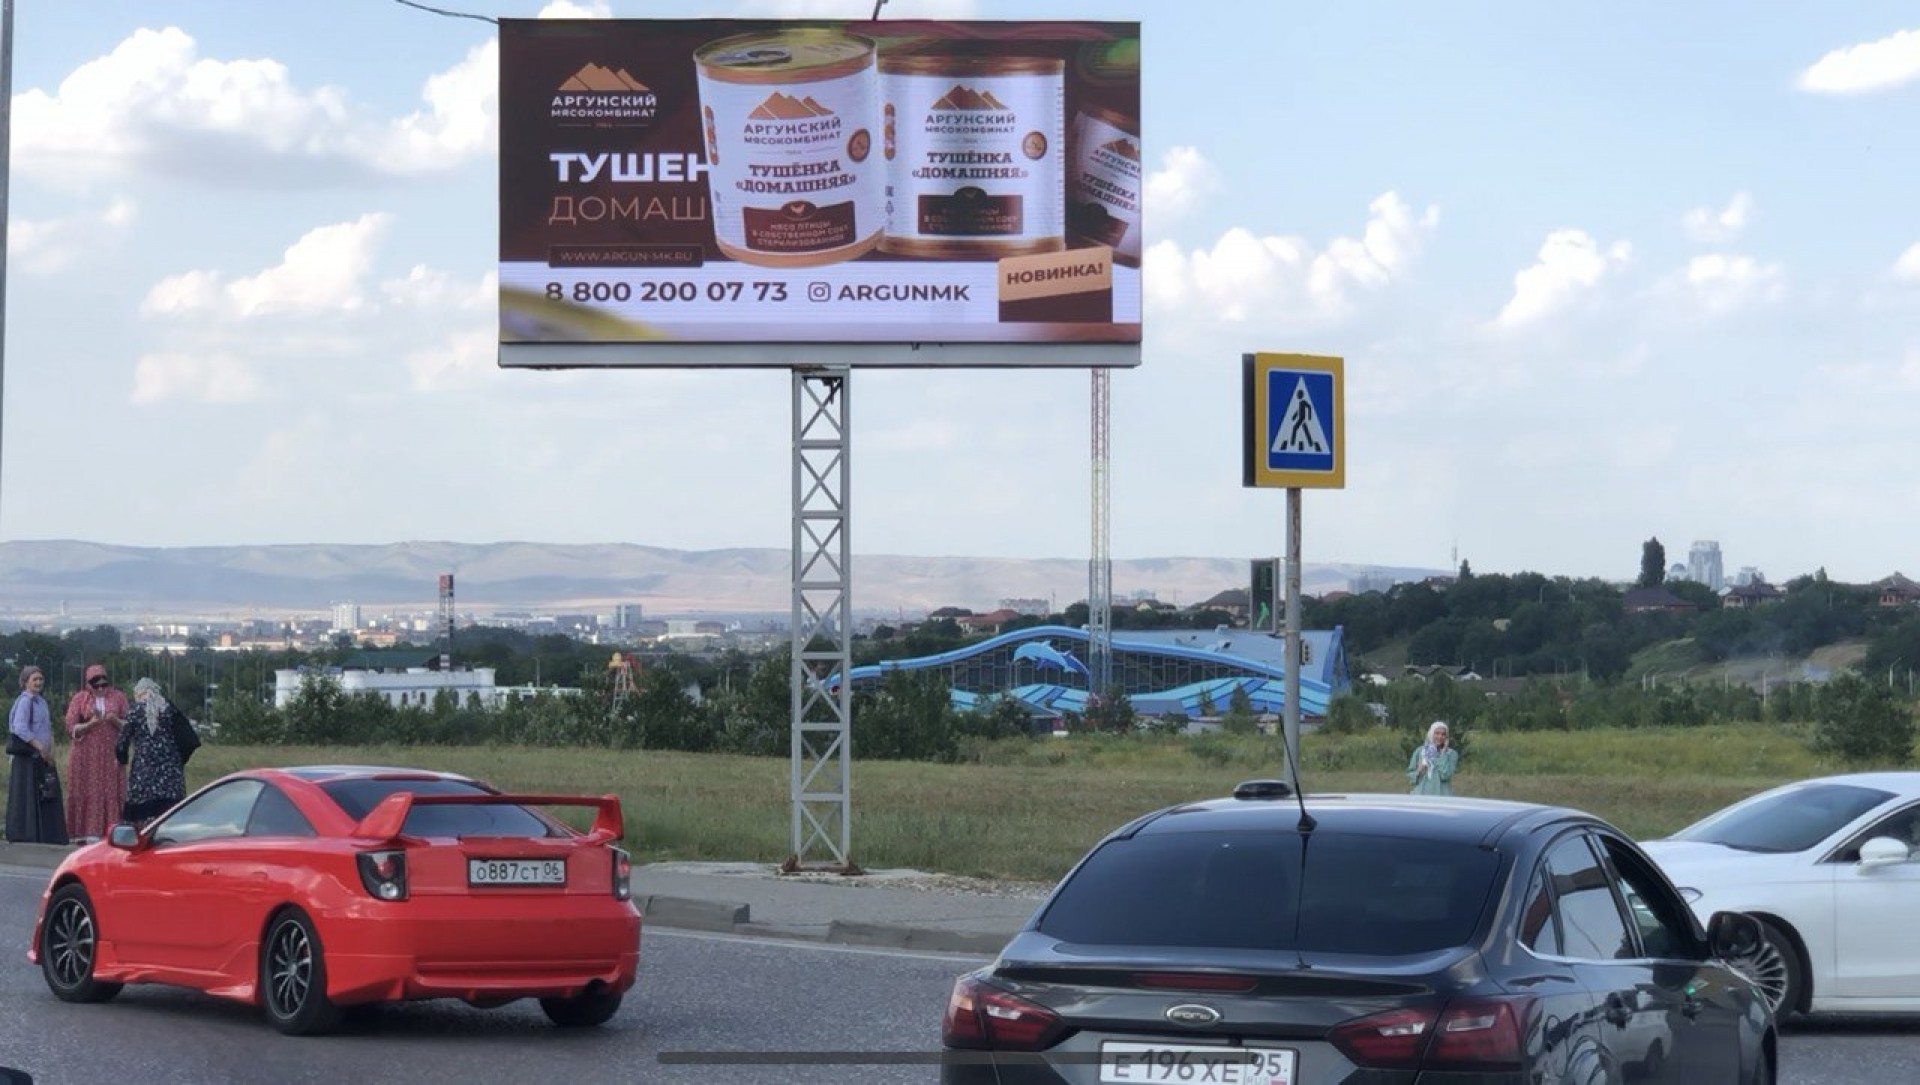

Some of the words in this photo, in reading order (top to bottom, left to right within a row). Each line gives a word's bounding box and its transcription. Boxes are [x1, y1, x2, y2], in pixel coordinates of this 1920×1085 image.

[551, 94, 657, 107] АРГУНСКИЙ
[551, 108, 655, 117] МЯСОКОМБИНАТ
[926, 112, 1016, 124] АРГУНСКИЙ
[744, 117, 841, 135] АРГУНСКИЙ
[925, 126, 1015, 134] МЯСОКОМБИНАТ
[744, 131, 841, 145] МЯСОКОМБИНАТ
[927, 150, 1012, 164] ТУШЁНКА
[748, 159, 841, 178] ТУШЁНКА
[912, 167, 1028, 179] «ДОМАШНЯЯ»
[736, 174, 856, 193] «ДОМАШНЯЯ»
[549, 196, 706, 225] ДОМАШ
[1007, 262, 1103, 285] НОВИНКА!
[546, 281, 563, 301] 8
[573, 281, 631, 301] 800
[641, 281, 697, 301] 200
[707, 281, 744, 301] 07
[753, 281, 788, 301] 73
[838, 284, 970, 301] ARGUNMK
